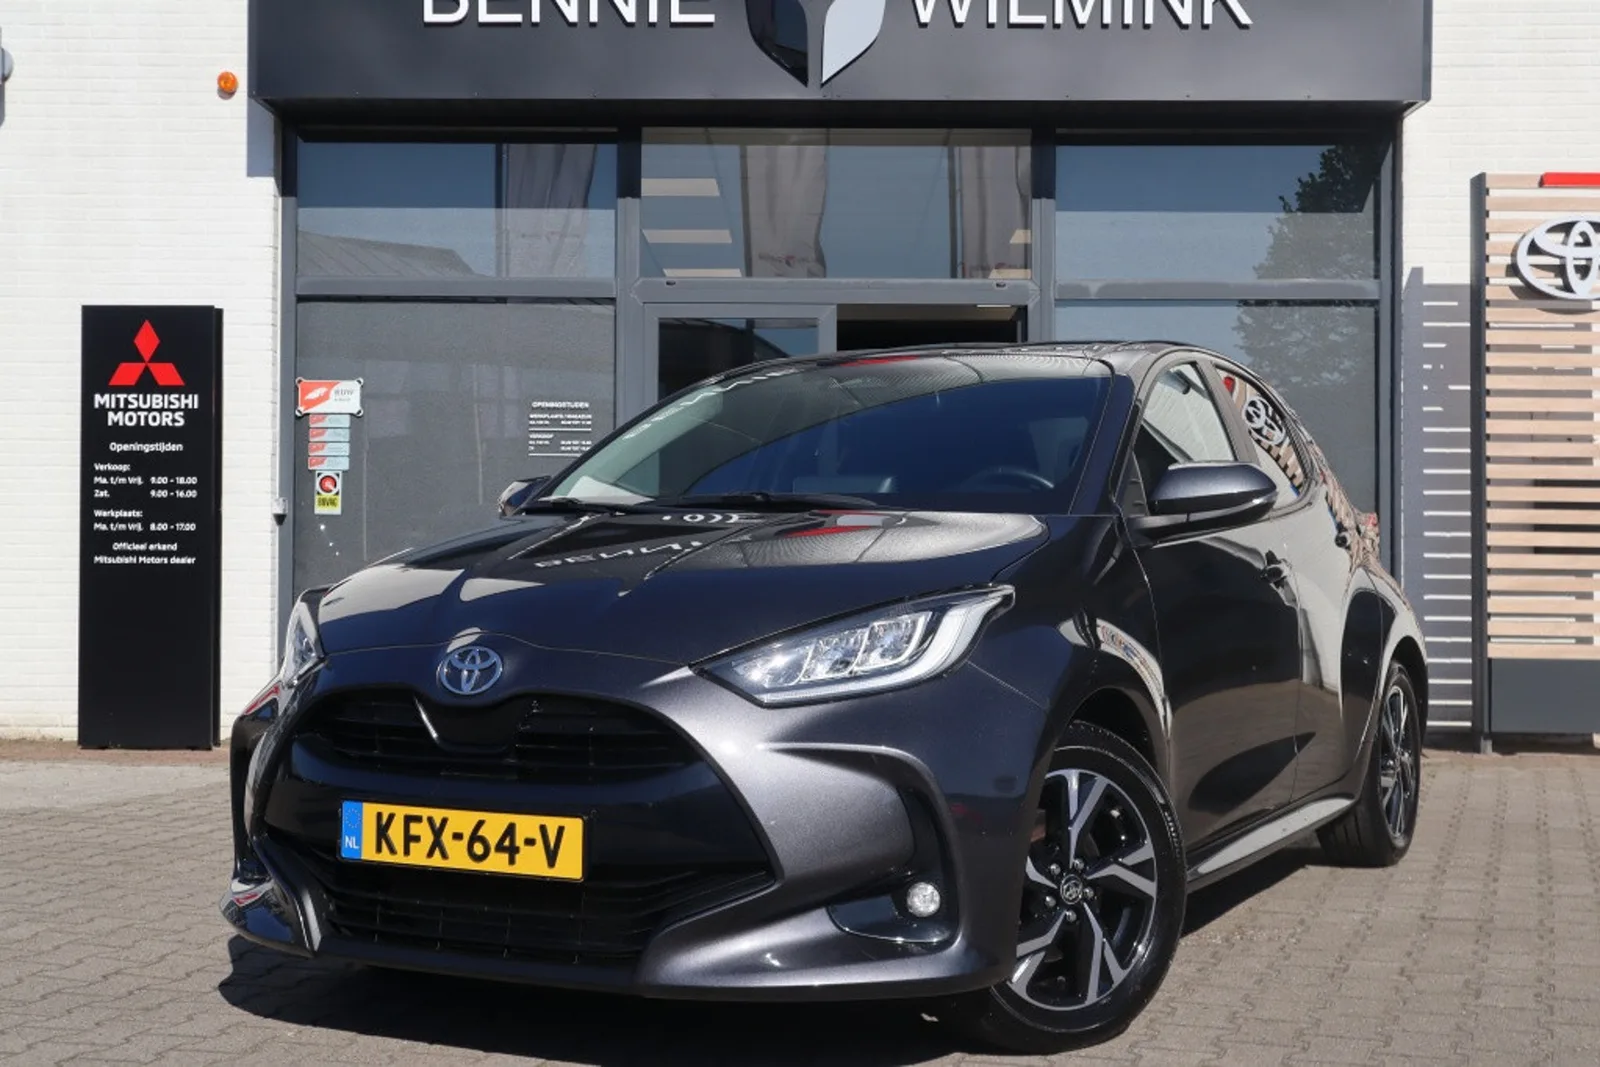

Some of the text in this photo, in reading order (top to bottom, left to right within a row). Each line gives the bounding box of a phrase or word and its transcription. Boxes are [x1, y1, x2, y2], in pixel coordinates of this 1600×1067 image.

[94, 393, 199, 409] MITSUBISHI
[108, 411, 185, 427] MOTORS
[109, 442, 183, 453] Openingstijden
[94, 463, 130, 472] Verkoop:
[110, 476, 127, 485] t/m
[150, 476, 168, 484] 9.00
[94, 489, 110, 497] Zat.
[150, 489, 168, 498] 9.00
[175, 490, 197, 498] 16.00
[94, 509, 143, 518] Werkplaats:
[110, 522, 127, 531] t/m
[150, 523, 168, 531] 8.00
[175, 523, 196, 531] 17.00
[148, 543, 177, 551] erkend
[94, 555, 196, 564] Mitsubishi Motors dealer
[344, 835, 359, 849] NL
[375, 811, 565, 868] KFX-64-V
